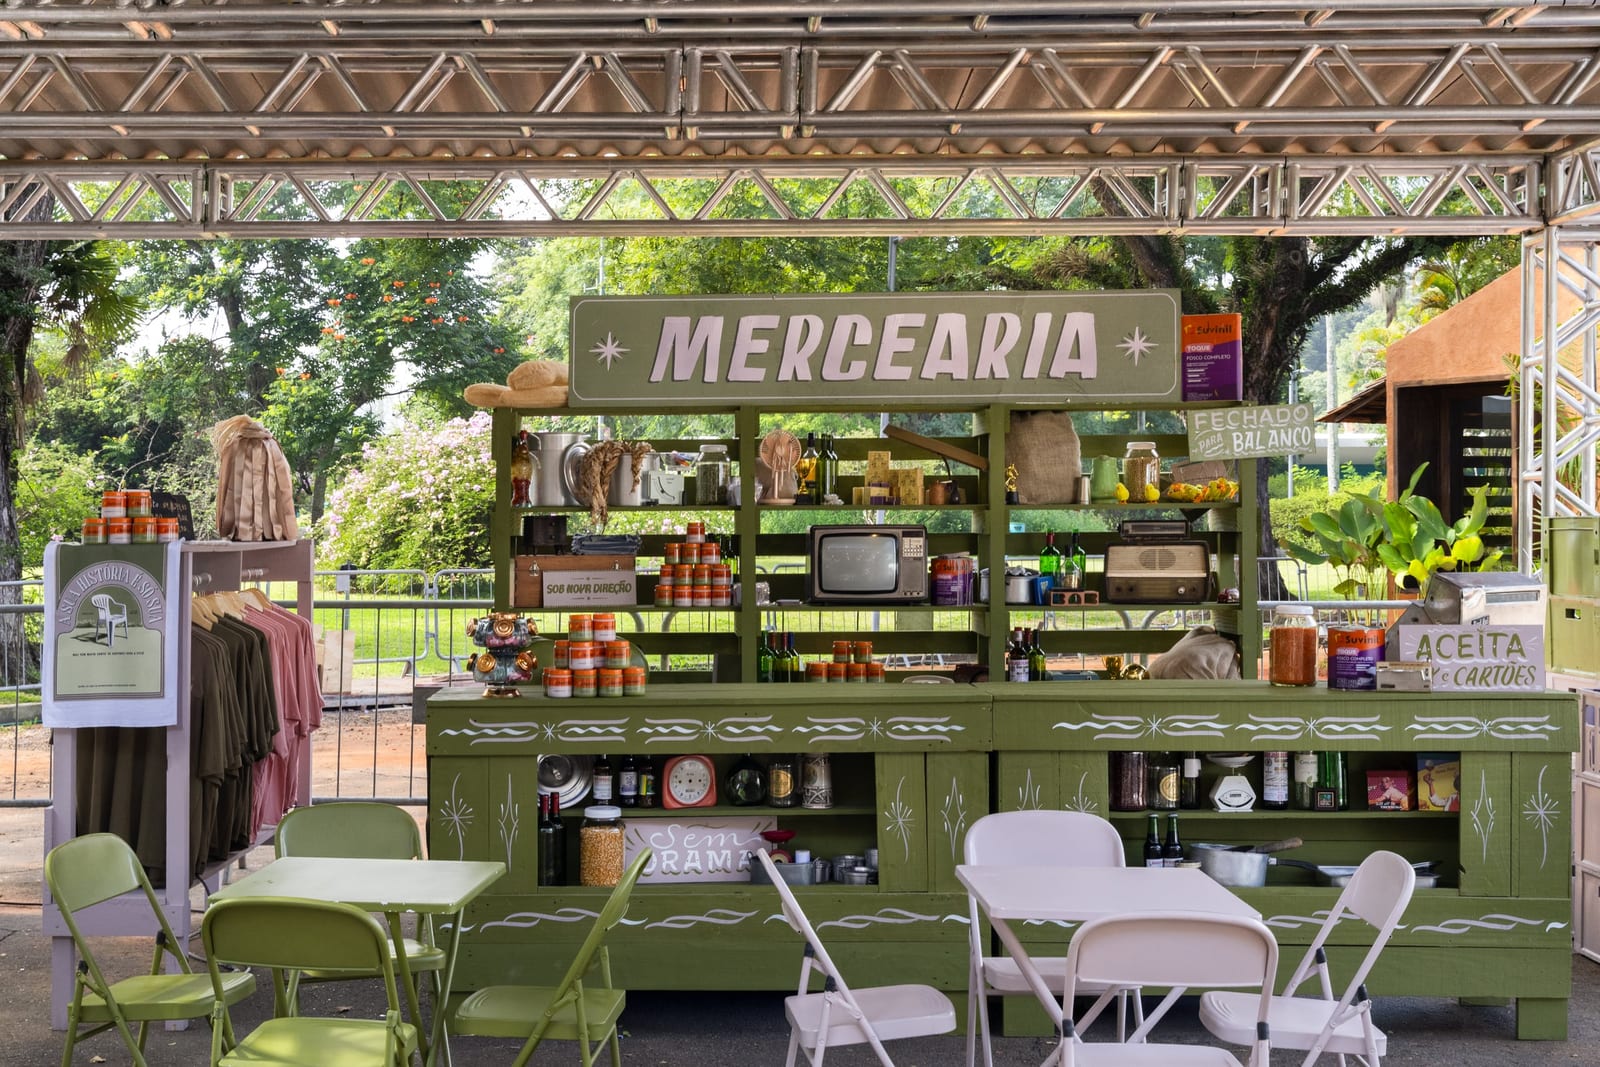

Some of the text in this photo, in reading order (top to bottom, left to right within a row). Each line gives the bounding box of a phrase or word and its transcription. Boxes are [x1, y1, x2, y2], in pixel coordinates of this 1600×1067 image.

[649, 312, 1098, 383] MERCEARIA
[1187, 344, 1211, 352] TOQUE
[1194, 405, 1310, 430] FECHADO
[1199, 426, 1312, 452] PARA BALANÇO
[75, 562, 130, 592] HISTÓRIA
[546, 579, 632, 595] SOB NOVA DIREÇÃO
[61, 589, 81, 615] SUA
[146, 597, 164, 625] SUA
[59, 615, 72, 627] A
[1345, 635, 1379, 644] Suvinil
[1416, 629, 1527, 660] ACEITA
[1453, 661, 1537, 687] CARTÕES
[650, 824, 762, 849] Sem
